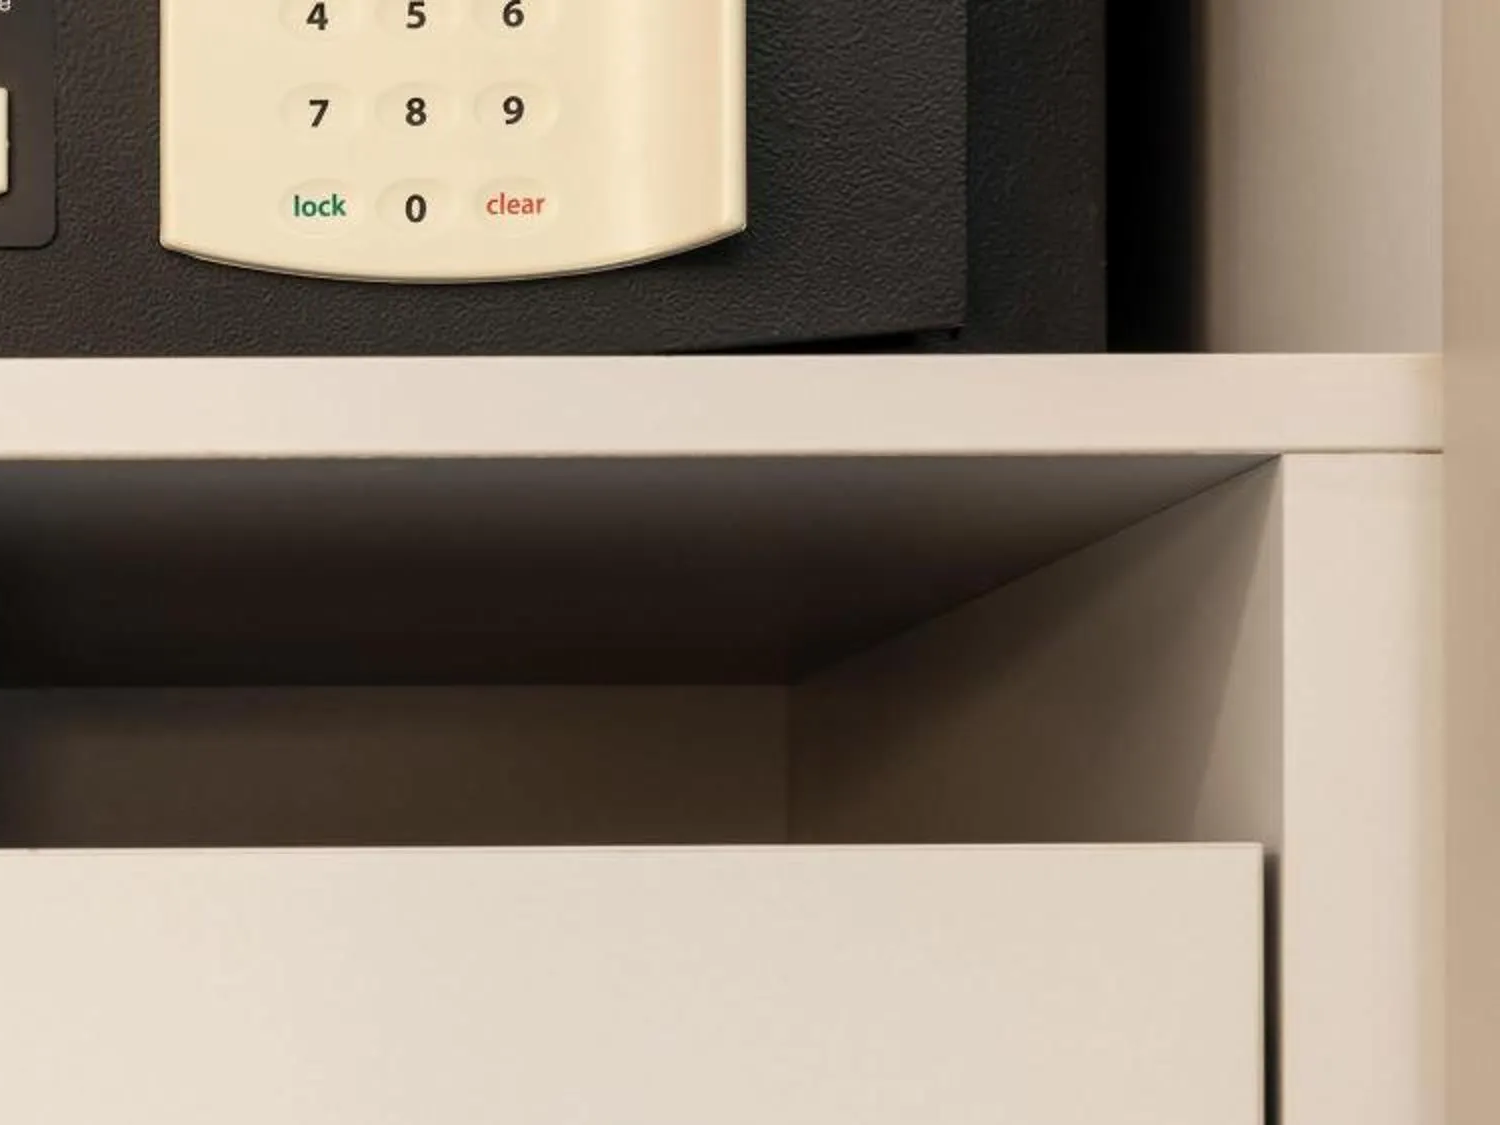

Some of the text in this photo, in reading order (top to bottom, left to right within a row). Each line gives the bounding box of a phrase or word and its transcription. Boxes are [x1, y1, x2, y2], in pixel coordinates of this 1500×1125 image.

[306, 2, 329, 31] 4
[406, 0, 427, 29] 5
[502, 0, 525, 28] 6
[308, 99, 329, 128] 7
[405, 97, 427, 127] 8
[502, 95, 525, 125] 9
[293, 193, 346, 217] lock
[405, 194, 427, 223] 0
[486, 192, 545, 216] clear
